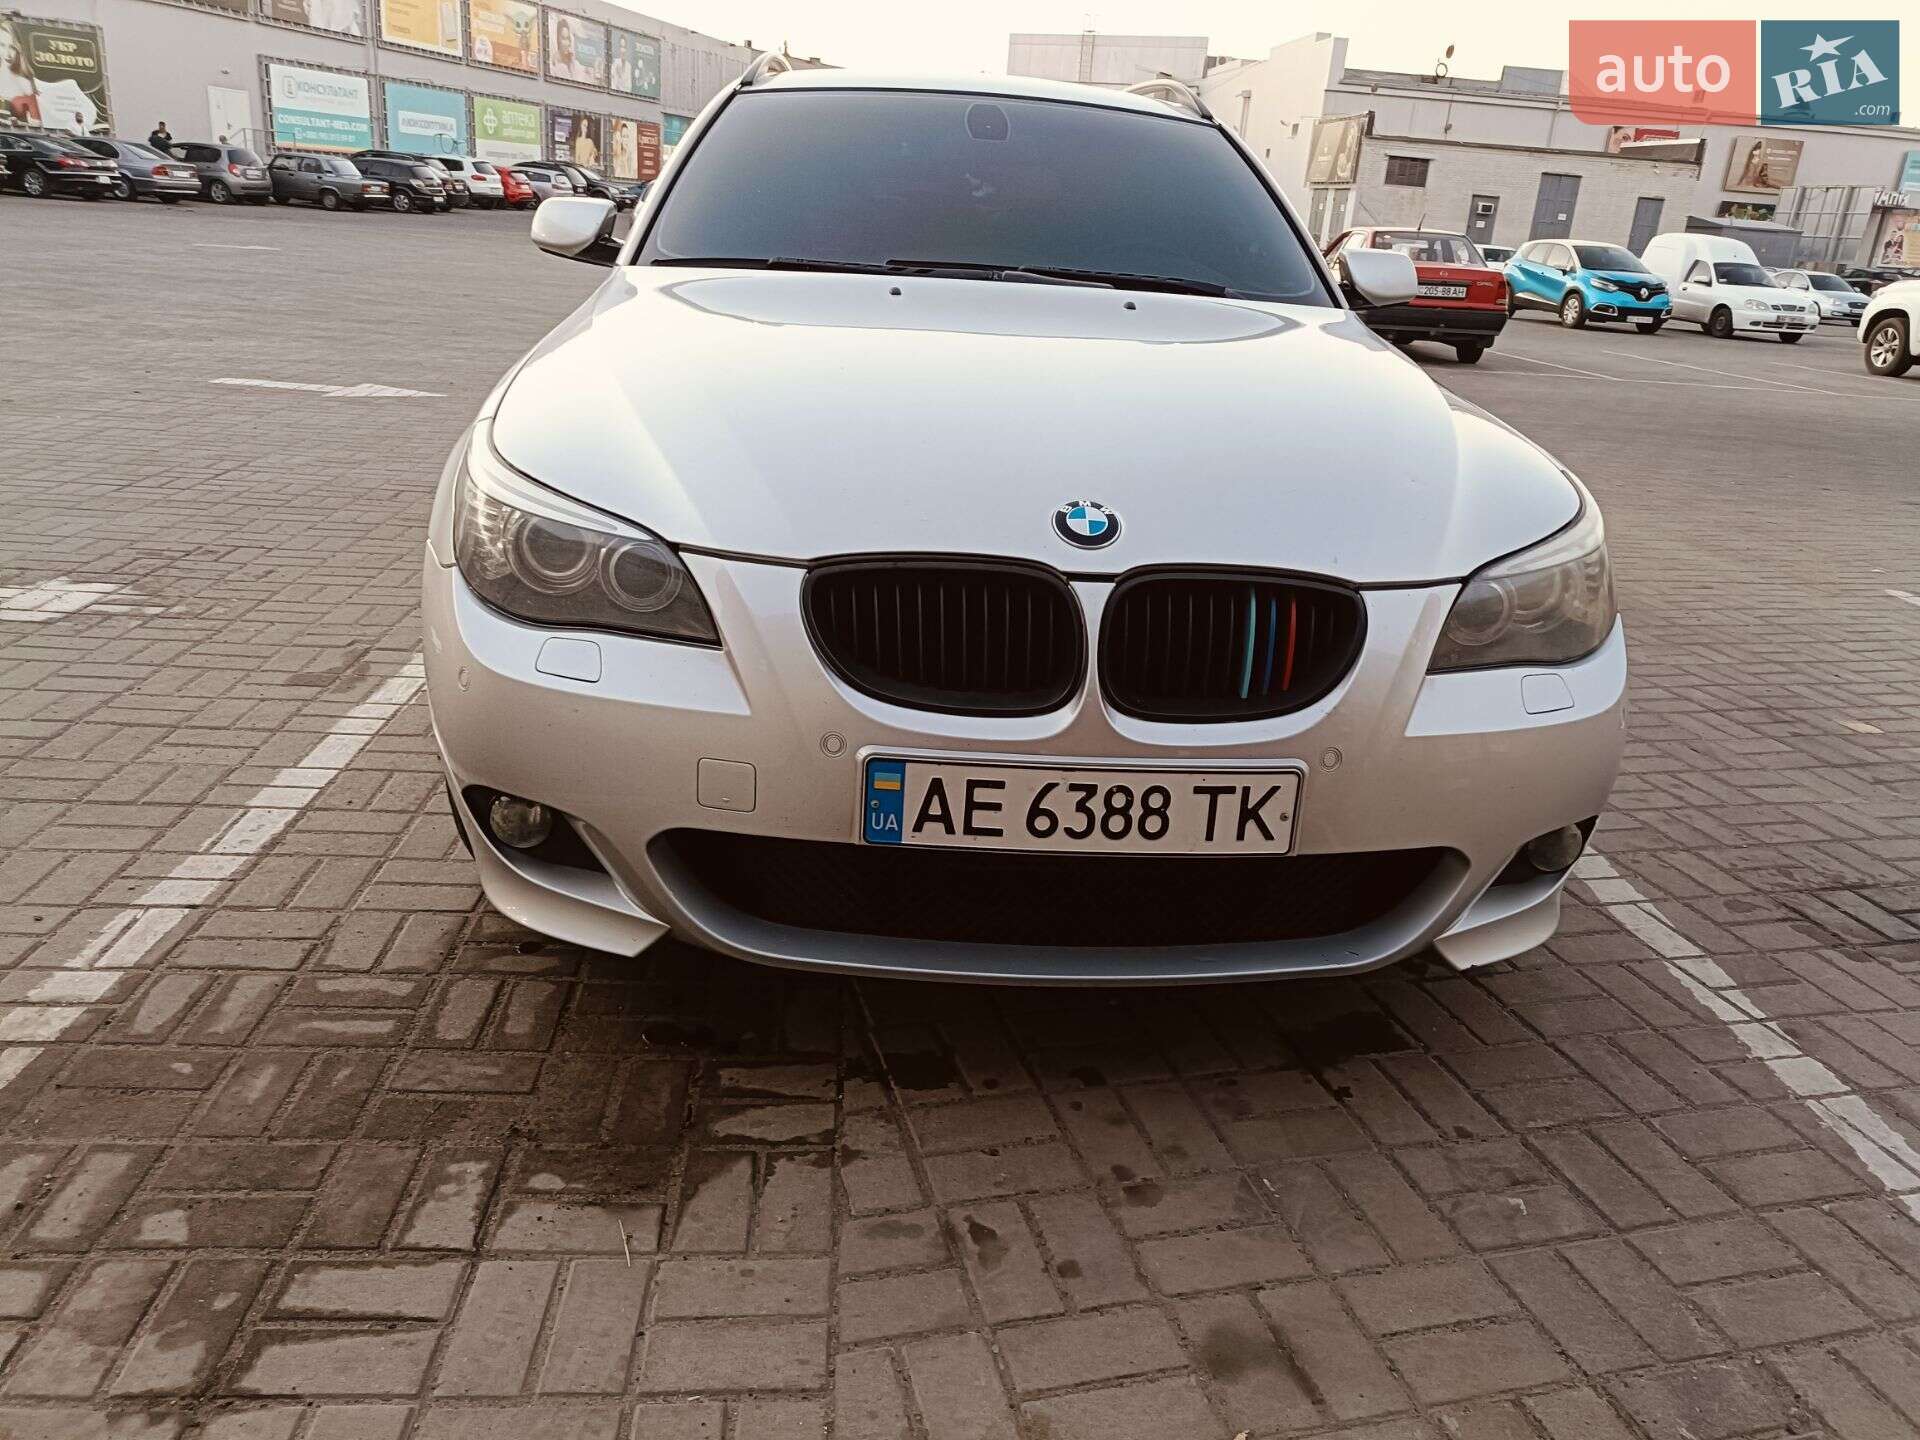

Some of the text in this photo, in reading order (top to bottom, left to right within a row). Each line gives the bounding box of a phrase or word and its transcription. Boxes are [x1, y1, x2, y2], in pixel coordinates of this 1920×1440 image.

[871, 813, 899, 830] UA
[911, 777, 1283, 842] AE 6388 TK
